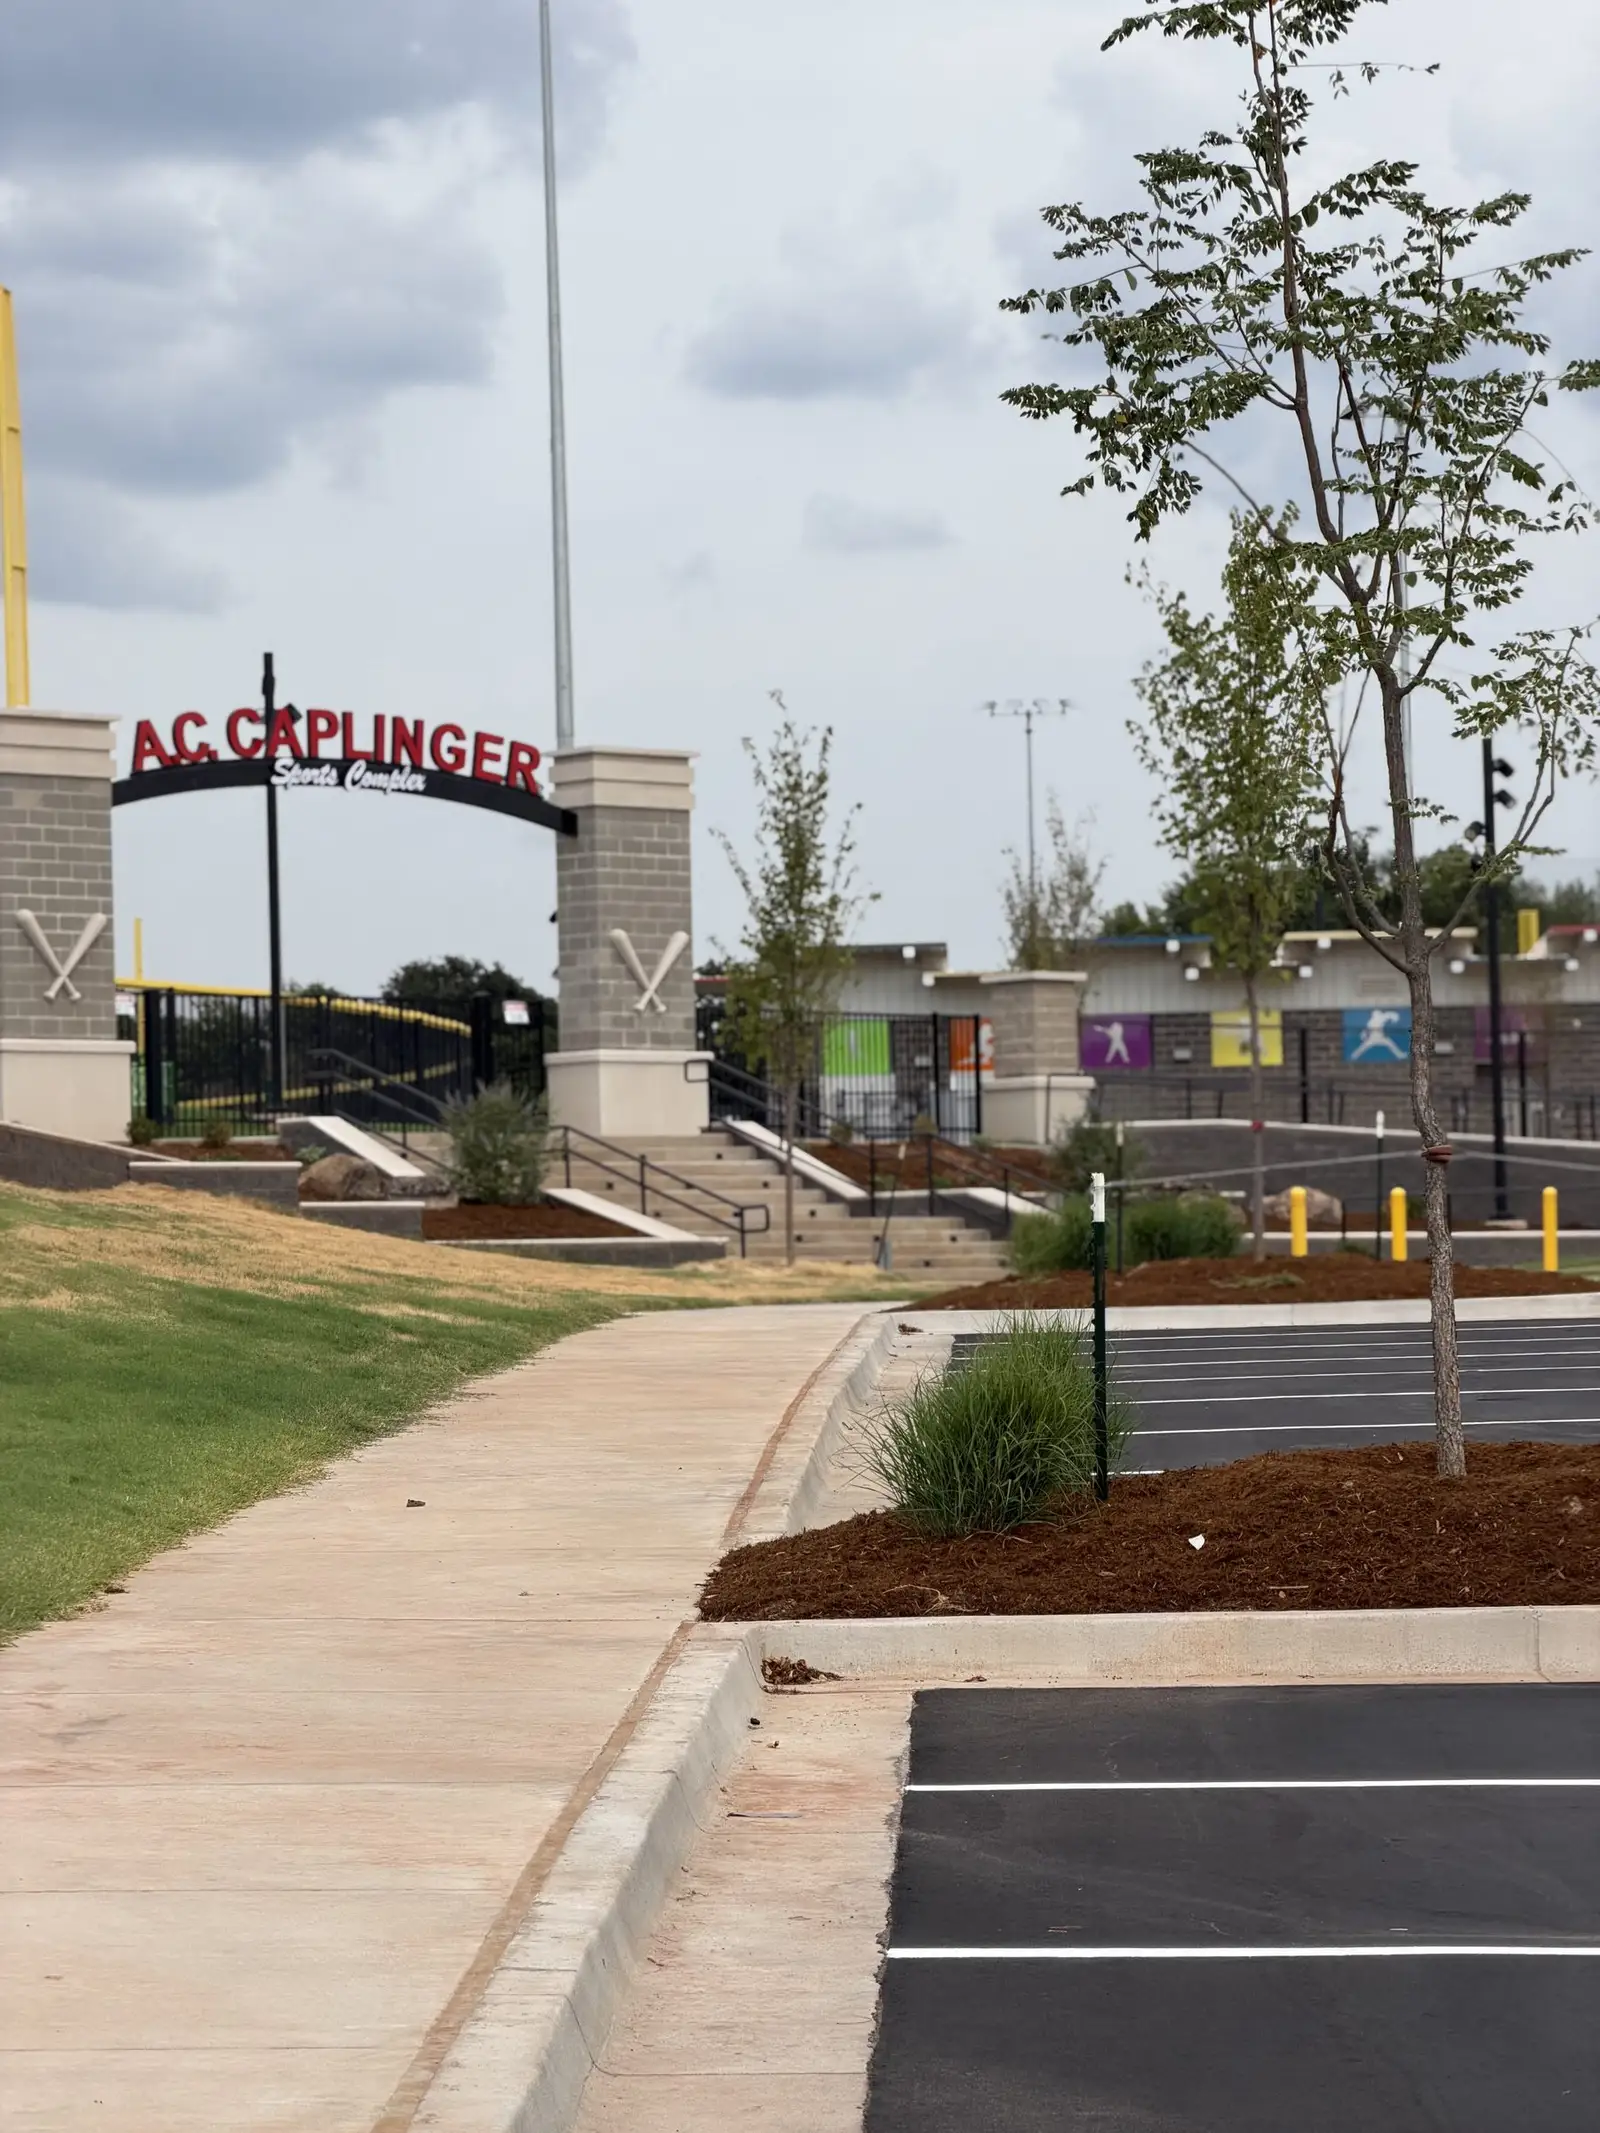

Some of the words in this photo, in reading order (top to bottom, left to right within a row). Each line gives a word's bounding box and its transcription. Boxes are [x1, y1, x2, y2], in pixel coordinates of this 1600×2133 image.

[131, 710, 219, 774] A.C.
[226, 707, 541, 797] CAPLINGER
[270, 757, 338, 790] Sports
[345, 759, 427, 795] Complex
